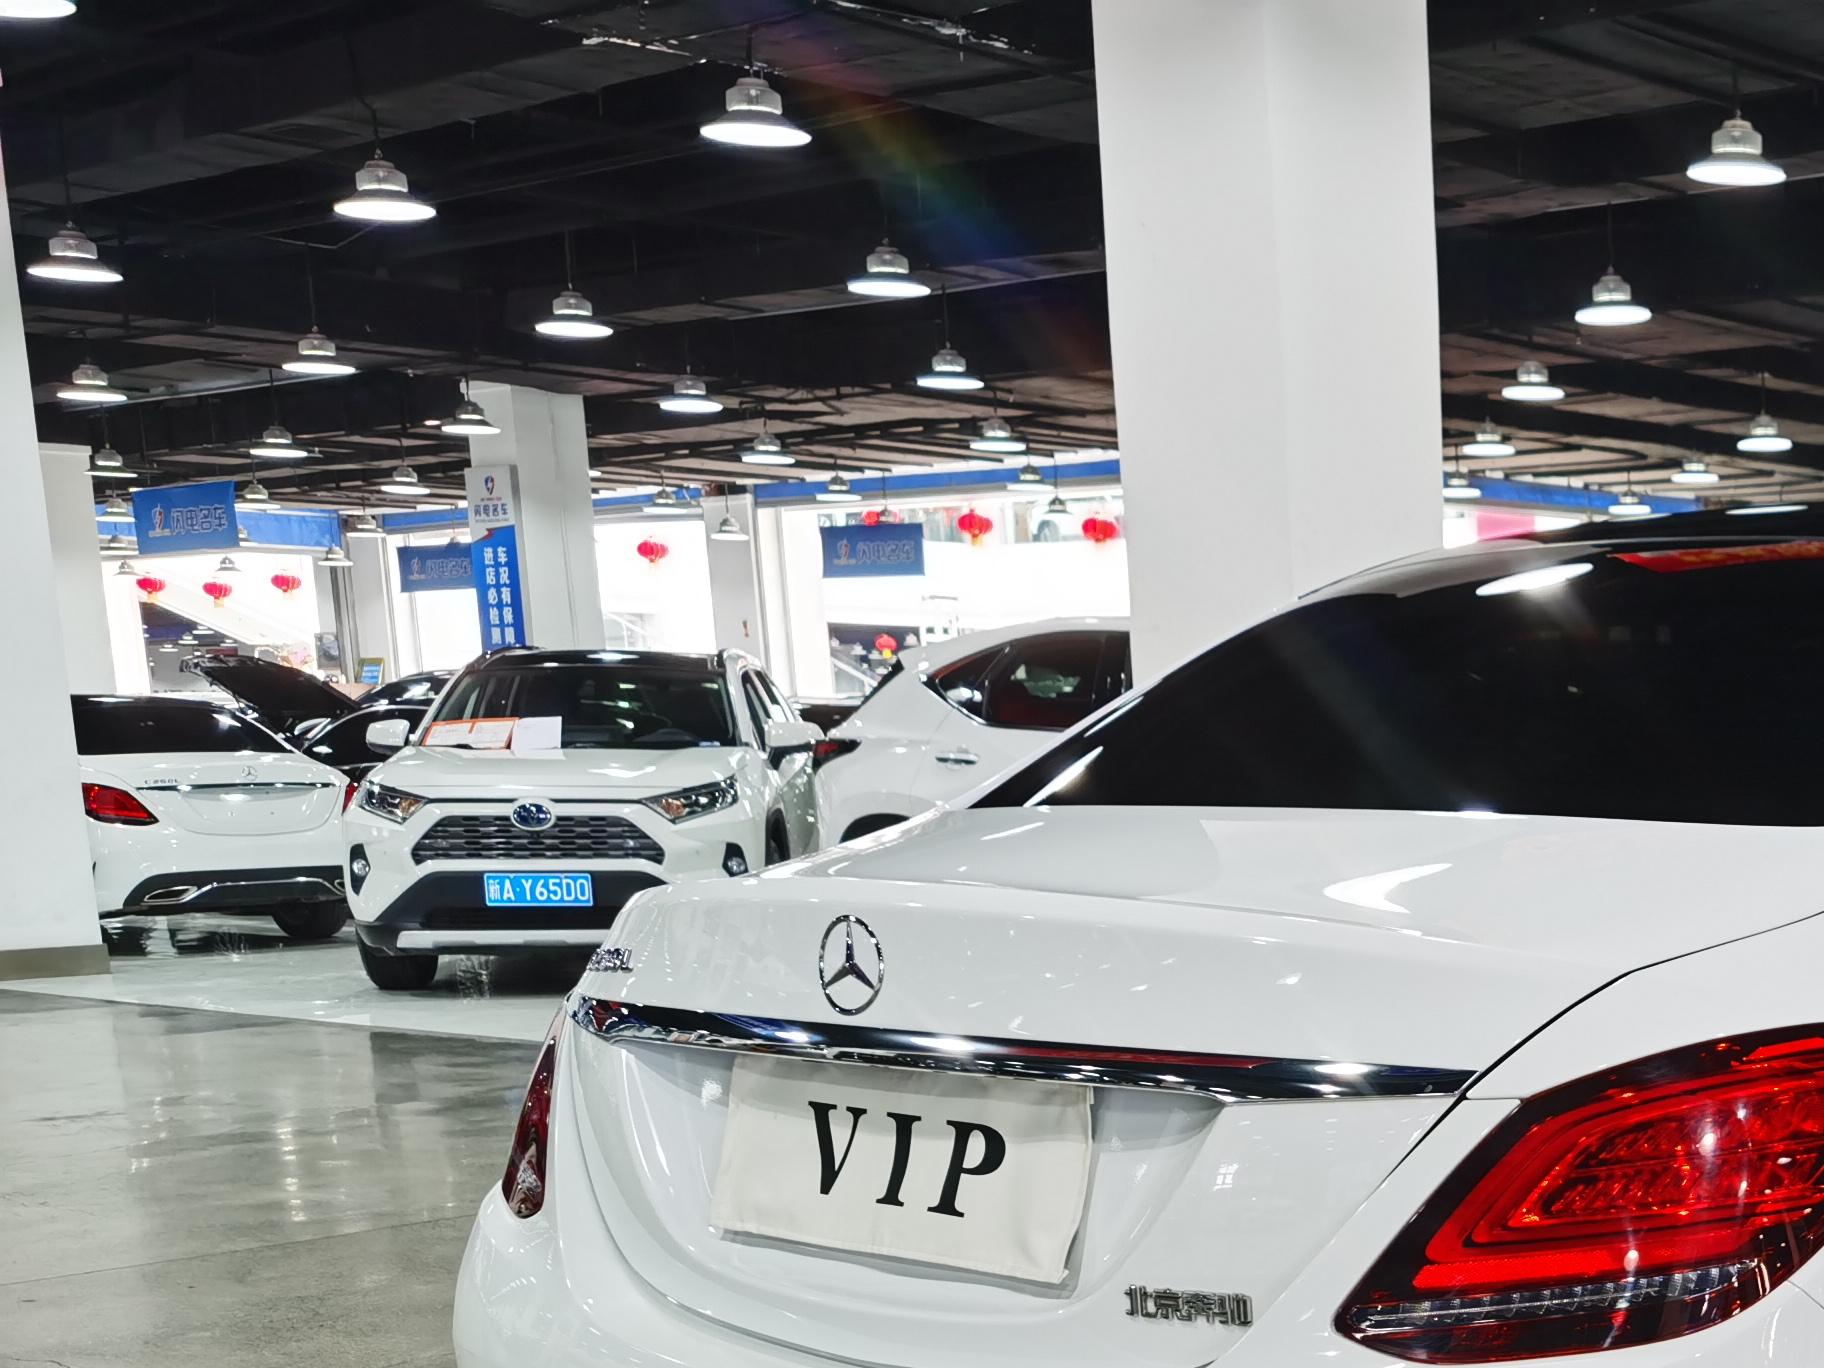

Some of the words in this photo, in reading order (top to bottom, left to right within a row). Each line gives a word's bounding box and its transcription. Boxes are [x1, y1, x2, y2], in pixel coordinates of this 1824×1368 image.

[171, 504, 228, 535] 闪电名车
[808, 1100, 1007, 1218] VIP
[1123, 1284, 1254, 1326] 北京奔驰
